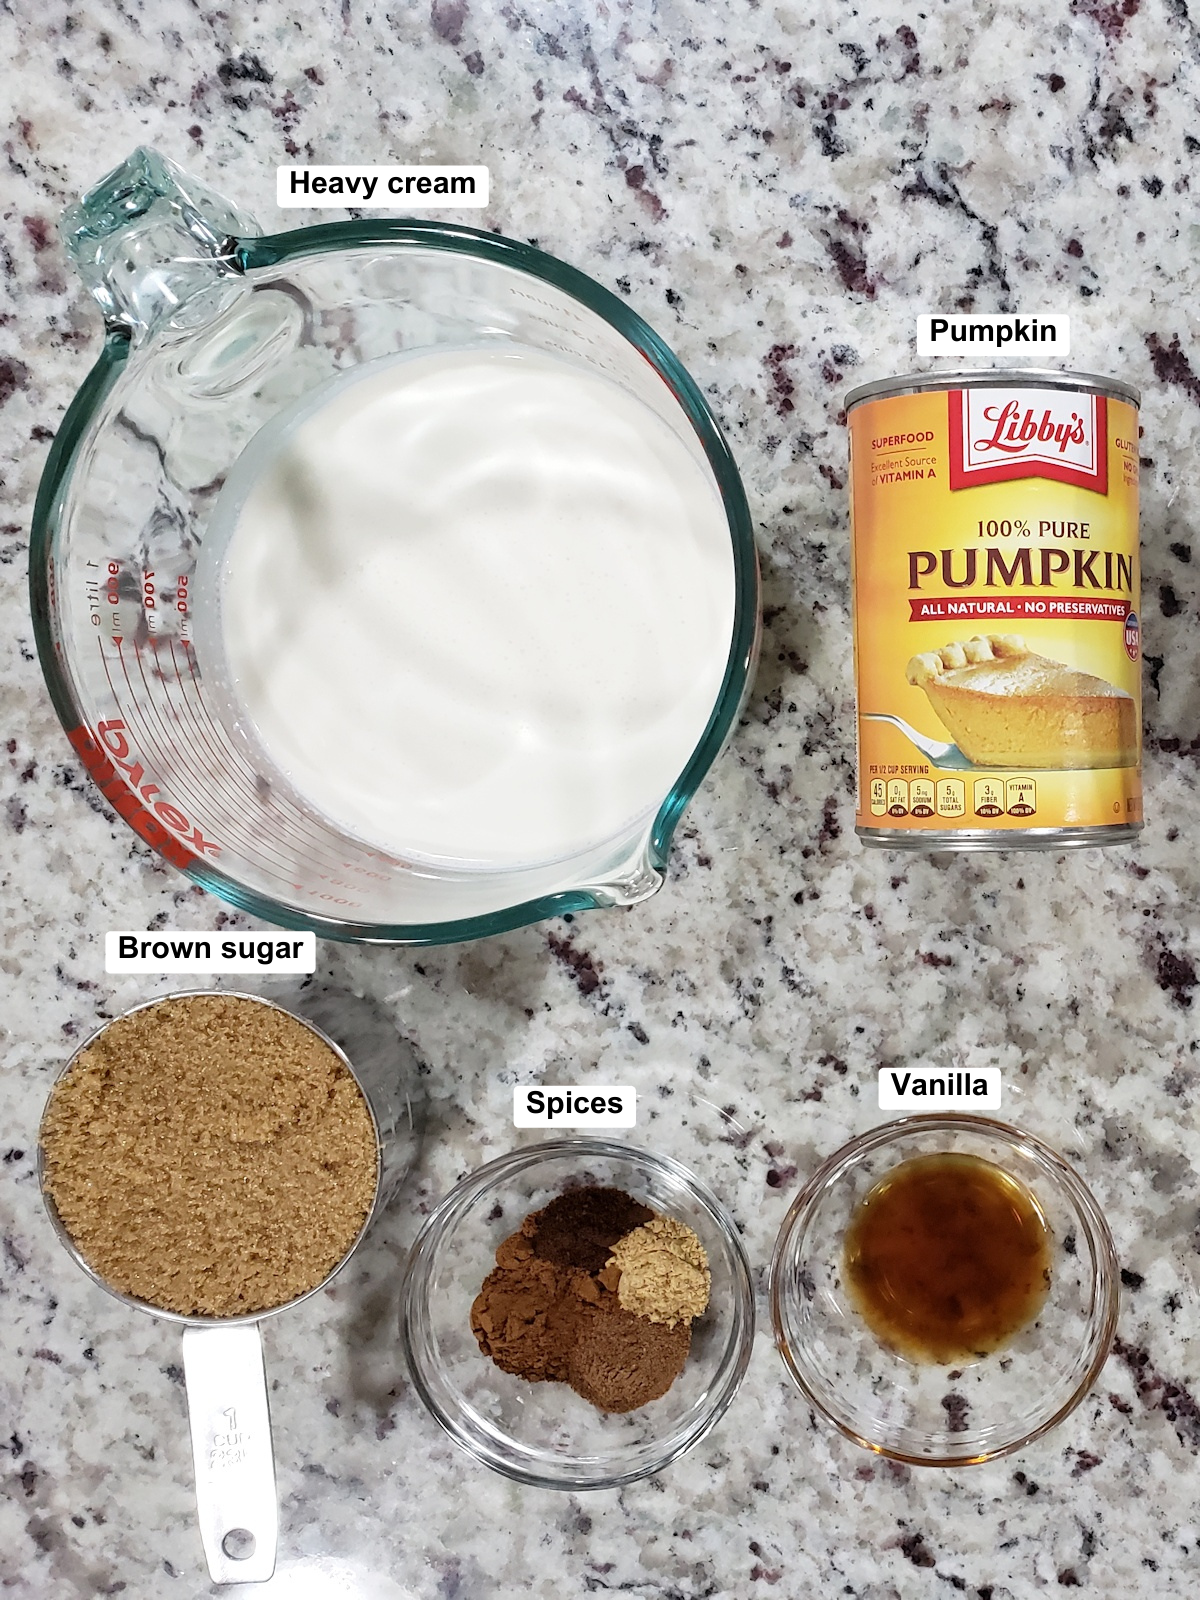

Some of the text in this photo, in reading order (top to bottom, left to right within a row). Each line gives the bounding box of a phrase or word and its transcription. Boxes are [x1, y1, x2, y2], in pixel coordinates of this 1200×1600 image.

[974, 400, 1085, 452] Libby's
[871, 431, 934, 450] SUPERFOOD
[871, 456, 937, 473] Excellent Source
[879, 469, 924, 485] VITAMIN
[927, 468, 937, 479] A
[977, 520, 1090, 539] 100% PURE
[908, 547, 1133, 592] PUMPKIN
[921, 602, 1126, 616] ALL NATURAL NO PRESERVATIVES
[869, 765, 878, 774] PER
[888, 765, 899, 774] CUP
[900, 765, 929, 774] SERVING
[873, 783, 883, 797] 45
[1018, 792, 1025, 803] A
